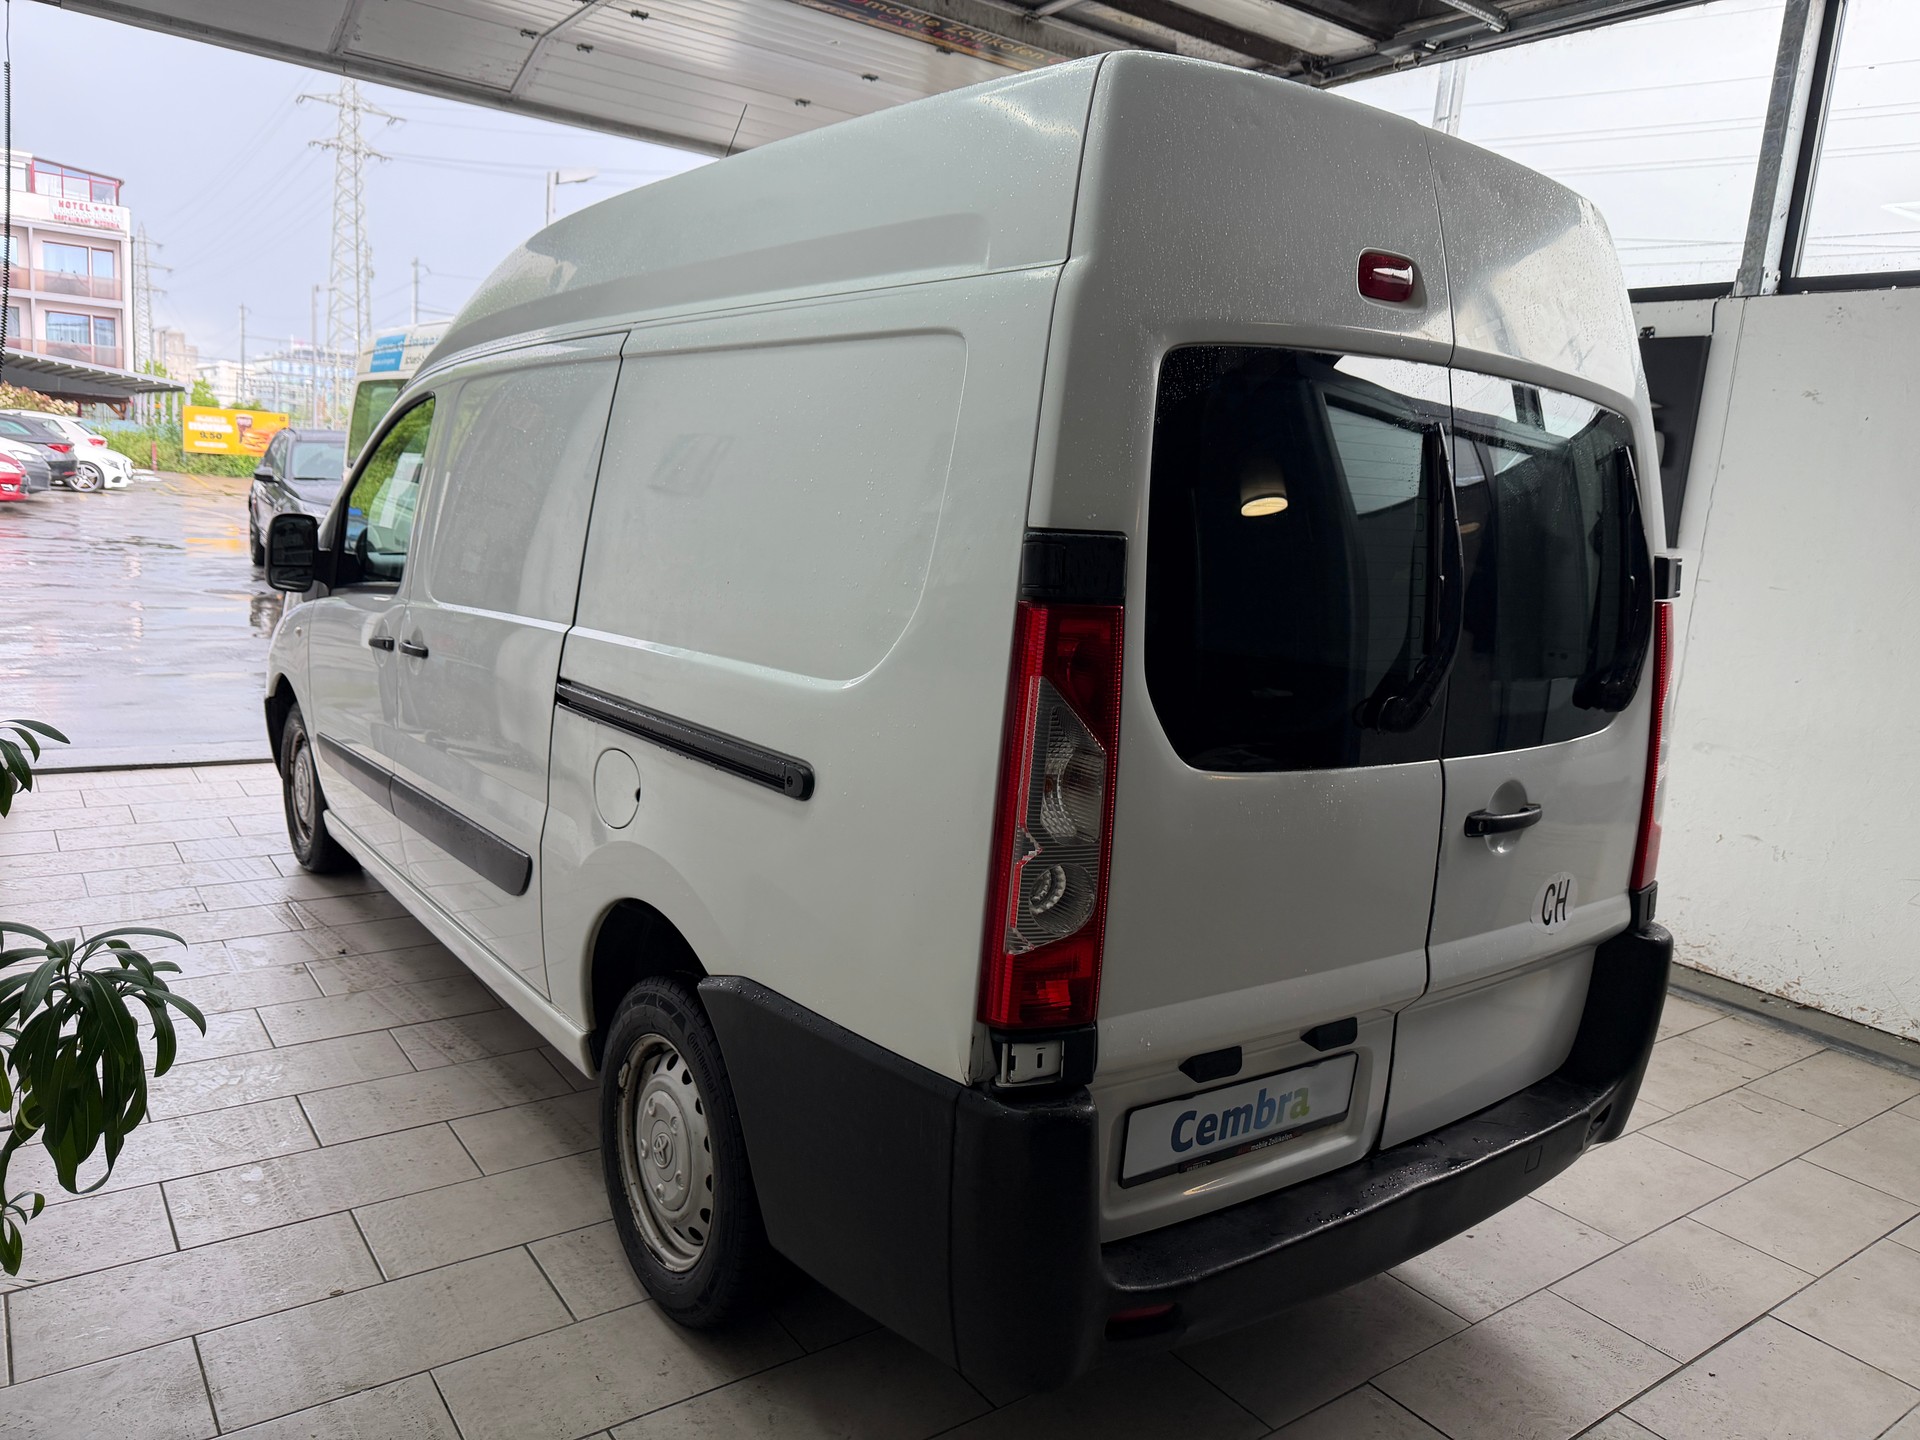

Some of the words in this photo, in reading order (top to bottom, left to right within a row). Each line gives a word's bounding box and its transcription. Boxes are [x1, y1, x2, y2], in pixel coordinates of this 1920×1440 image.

[877, 14, 917, 29] CAR
[918, 26, 985, 50] CENTER
[943, 22, 1046, 61] Zollikofen
[58, 200, 90, 211] HOTEL
[1541, 878, 1571, 926] CH
[687, 1032, 716, 1094] Continental
[1170, 1086, 1310, 1153] Cembra
